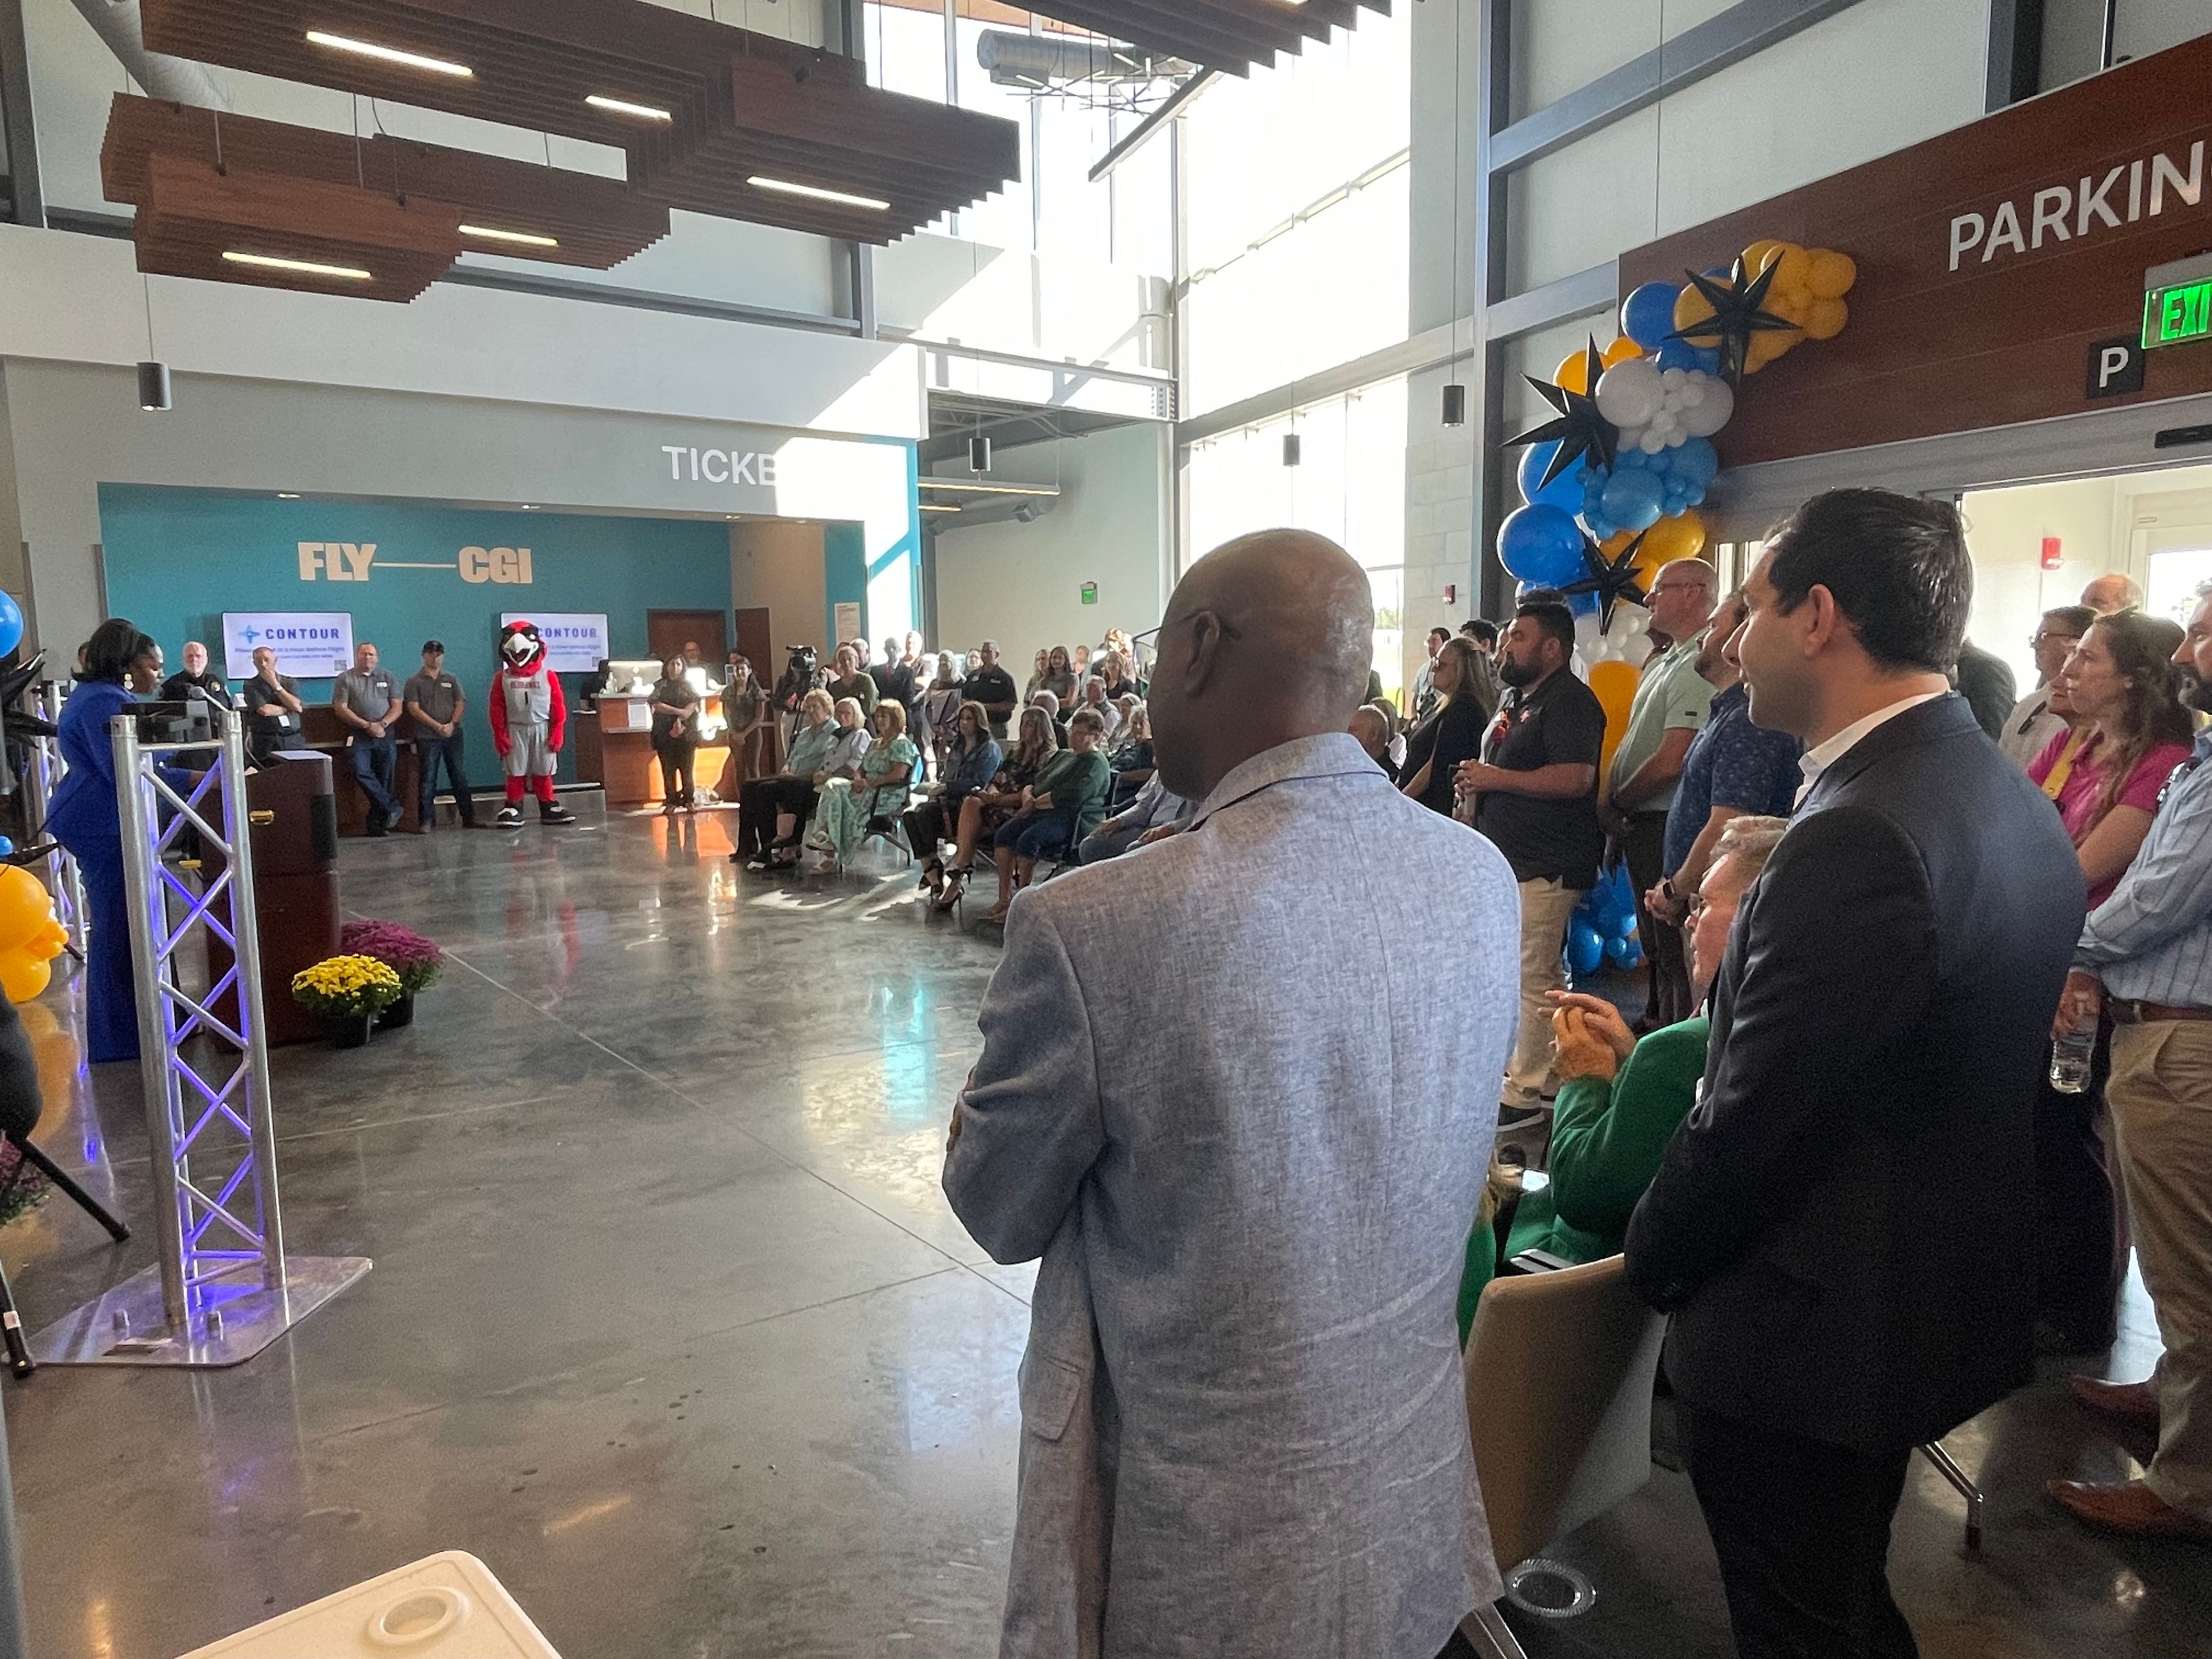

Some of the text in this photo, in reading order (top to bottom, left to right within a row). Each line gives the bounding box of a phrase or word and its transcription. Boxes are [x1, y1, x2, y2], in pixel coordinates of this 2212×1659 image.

[1948, 140, 2212, 272] PARKIN
[2160, 282, 2212, 341] EXI
[2099, 346, 2129, 388] P
[297, 541, 533, 584] FLY CGI
[265, 628, 339, 639] CONTOUR
